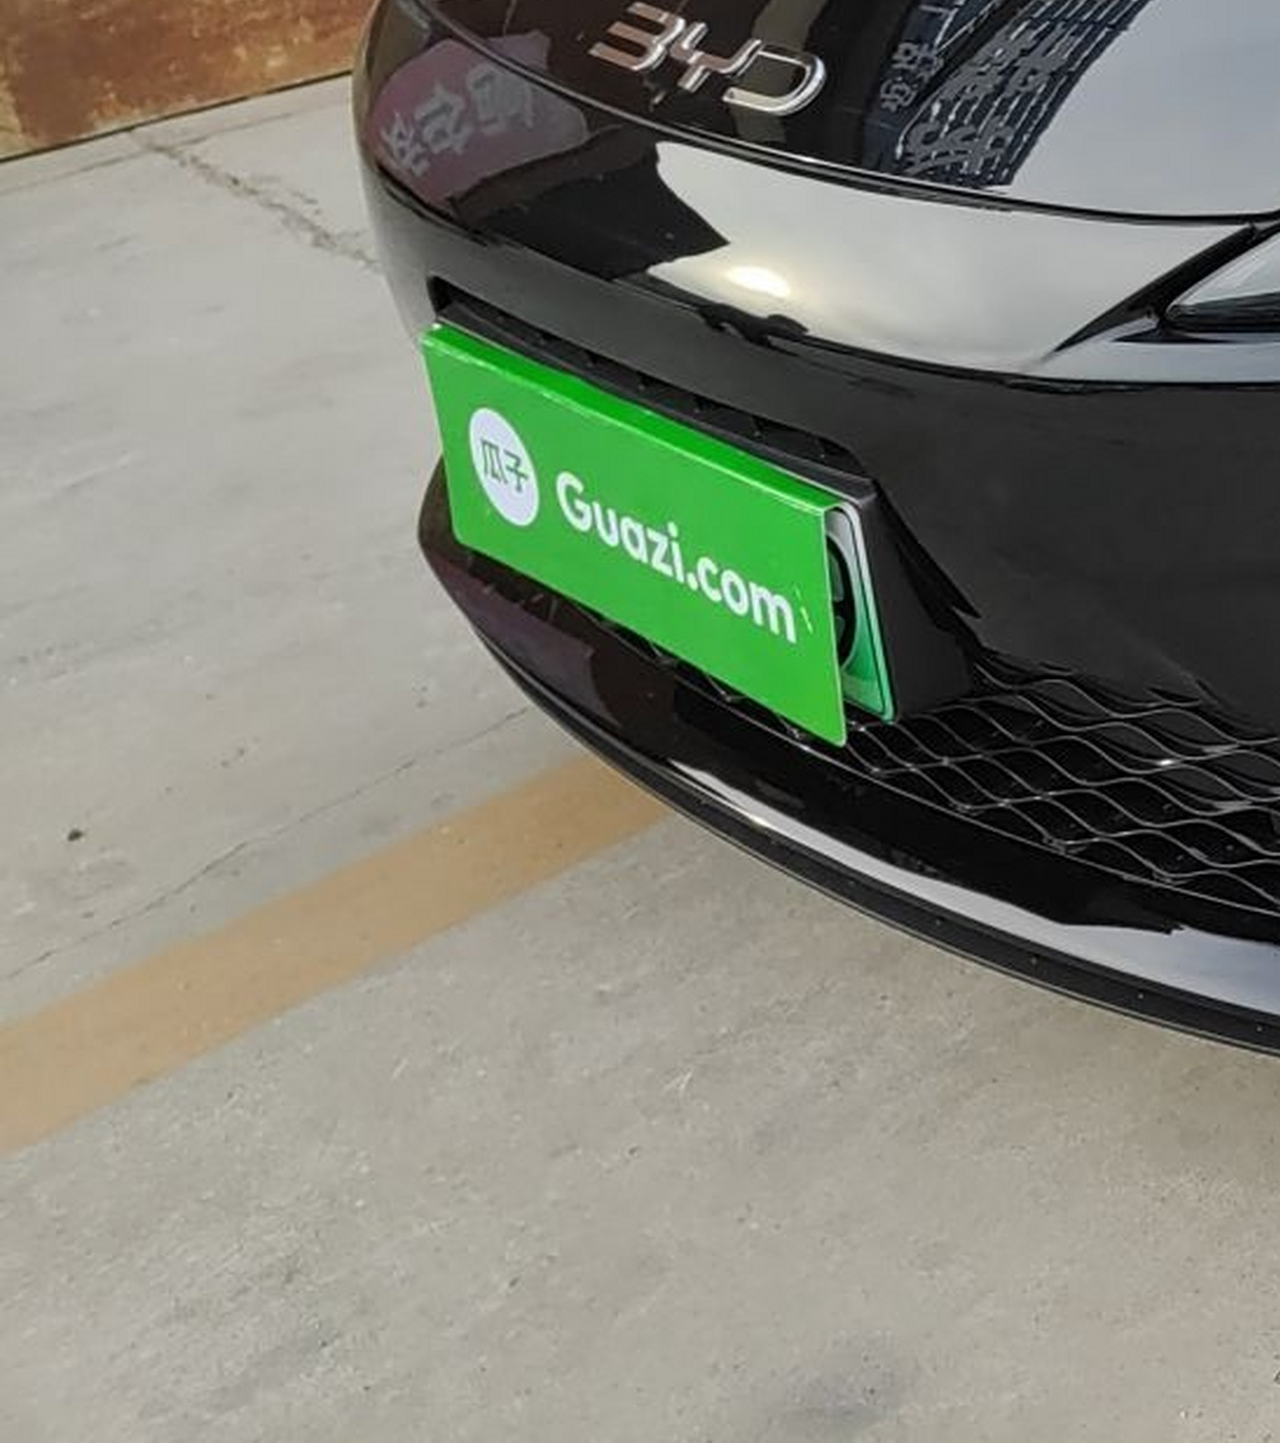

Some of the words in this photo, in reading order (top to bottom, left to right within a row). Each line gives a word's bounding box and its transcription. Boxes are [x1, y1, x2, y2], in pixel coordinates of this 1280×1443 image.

[587, 1, 827, 115] BYD
[480, 437, 530, 492] 瓜子
[556, 471, 797, 644] Guazi.com
